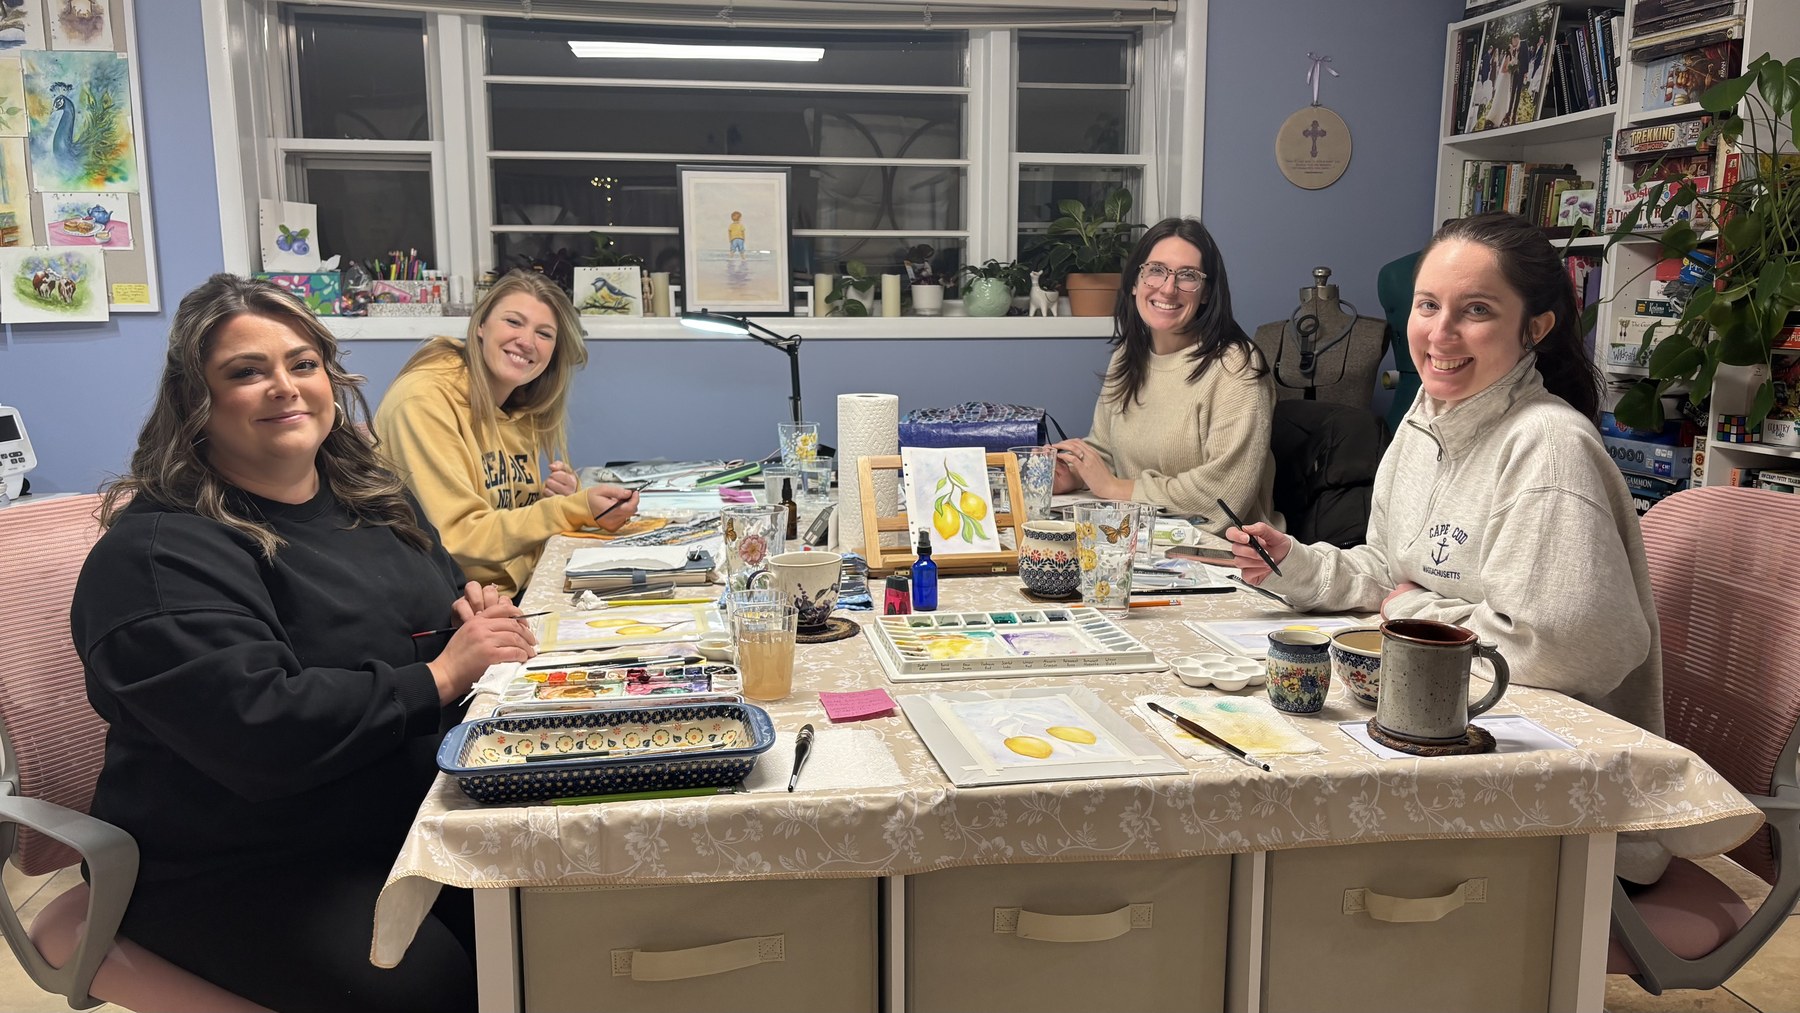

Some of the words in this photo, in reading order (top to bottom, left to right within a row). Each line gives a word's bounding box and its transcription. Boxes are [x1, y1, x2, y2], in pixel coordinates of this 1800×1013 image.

[1631, 126, 1675, 147] TREKKING
[1429, 524, 1450, 538] CAPE
[1452, 527, 1468, 545] COD
[1423, 565, 1461, 580] MASSACHUSETTS
